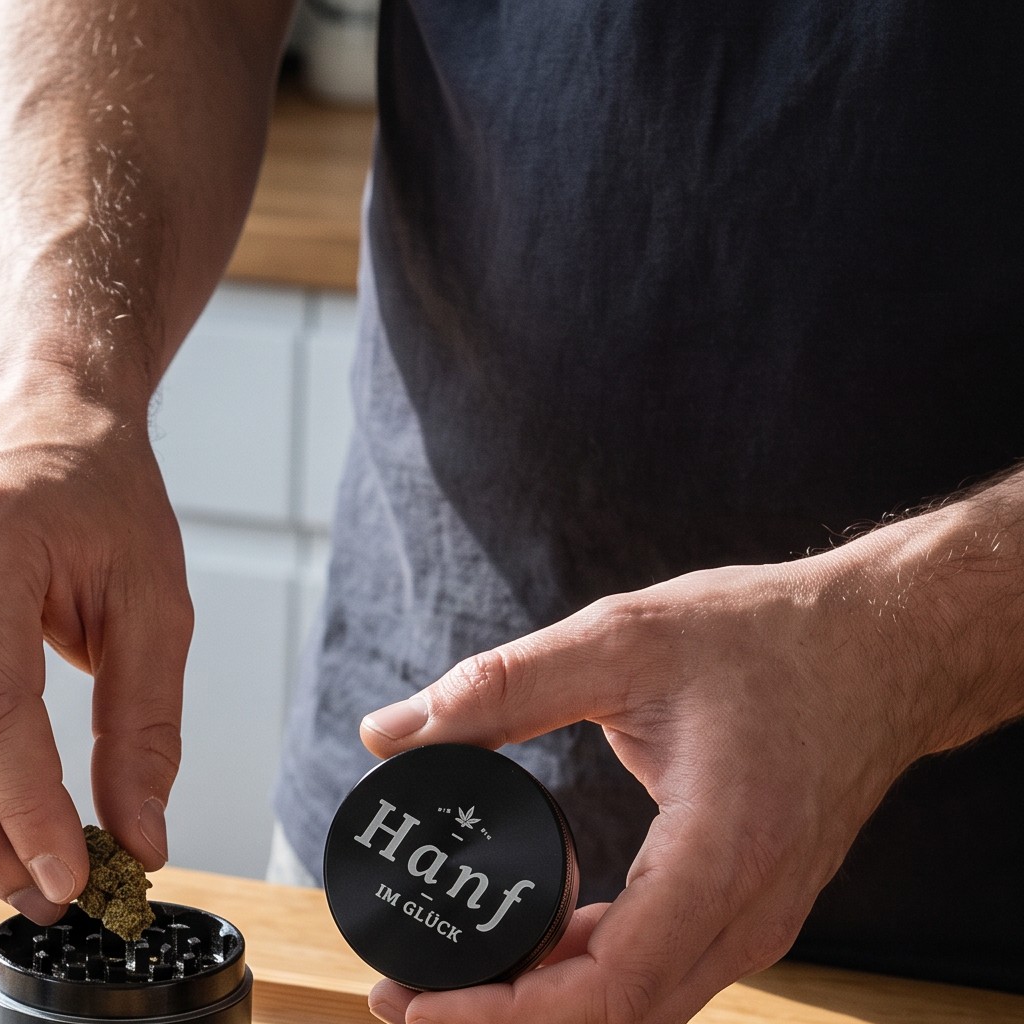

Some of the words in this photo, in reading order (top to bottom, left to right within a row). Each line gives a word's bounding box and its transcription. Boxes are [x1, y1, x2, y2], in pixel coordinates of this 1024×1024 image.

[354, 799, 536, 932] Hanf
[375, 883, 401, 907] IM
[402, 901, 463, 944] GLÜCK
